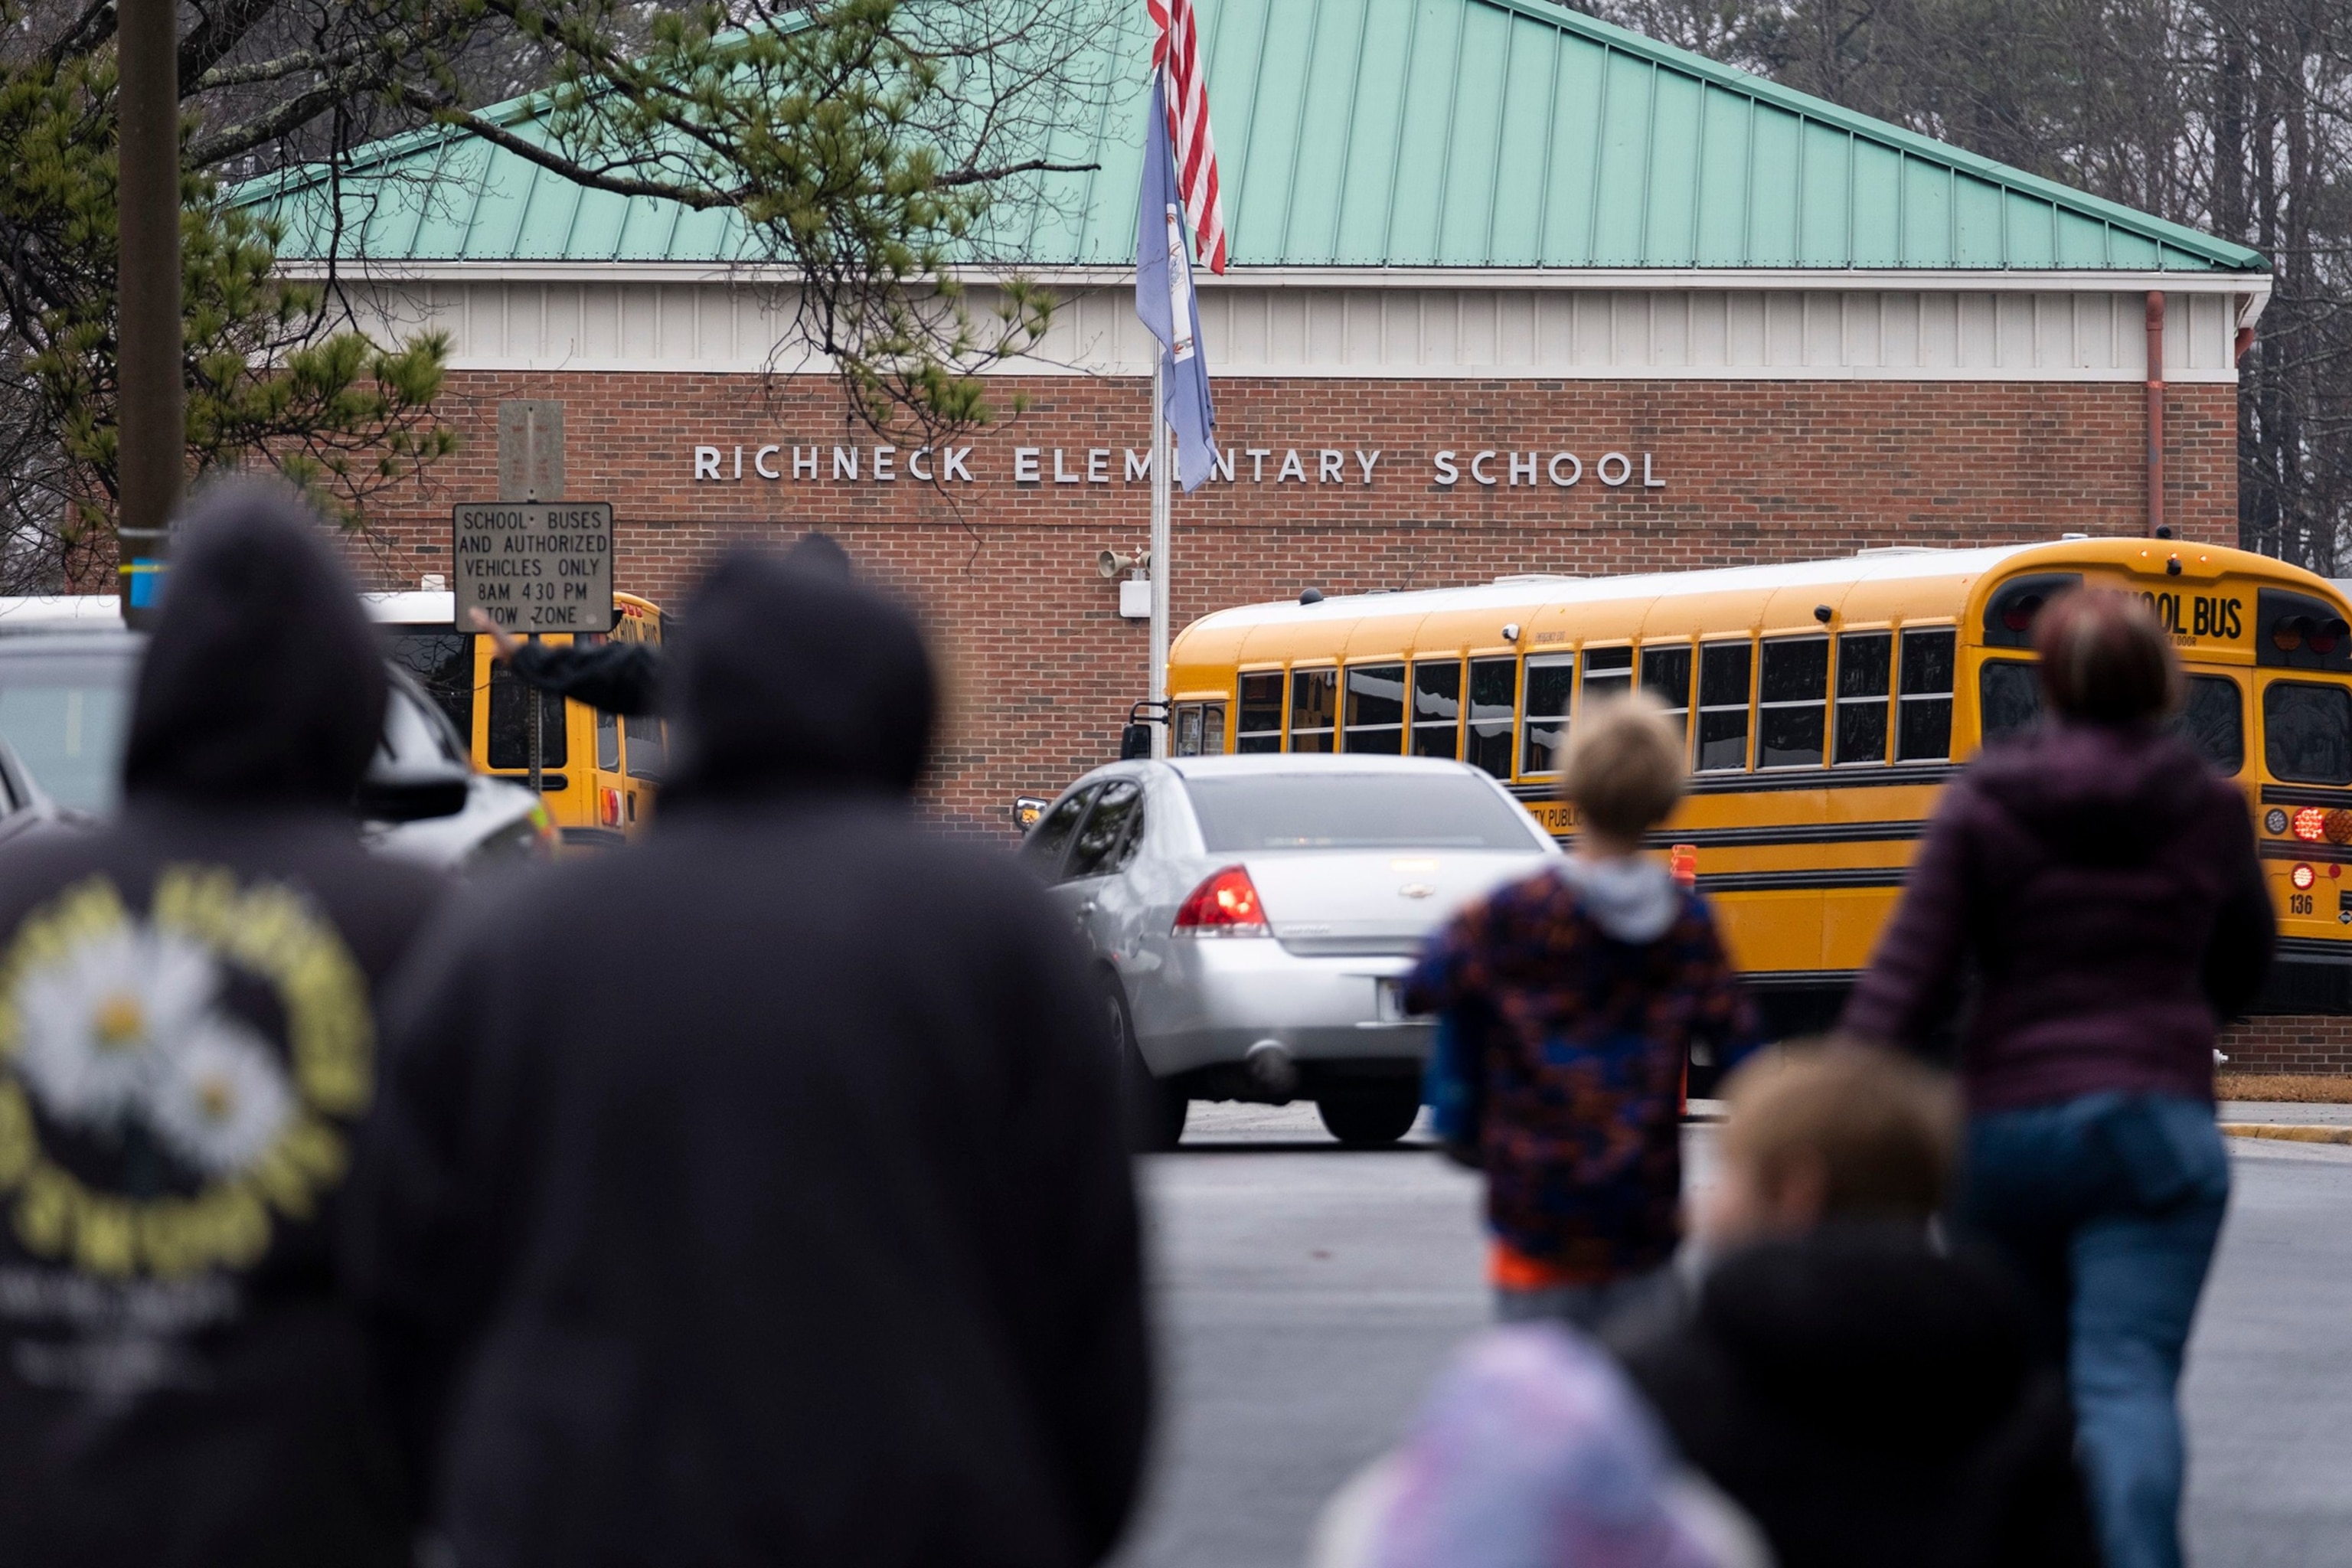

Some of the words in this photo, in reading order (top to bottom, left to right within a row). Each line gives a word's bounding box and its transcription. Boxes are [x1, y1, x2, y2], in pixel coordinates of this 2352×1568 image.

[694, 445, 973, 483] RICHNECK
[1434, 449, 1666, 487] SCHOOL
[464, 511, 527, 530] SCHOOL
[548, 511, 602, 529] BUSES
[459, 536, 492, 553] AND
[504, 535, 607, 553] AUTHORIZED
[466, 559, 541, 577] VEHICLES
[558, 558, 599, 576] ONLY
[478, 583, 511, 600] 8AM
[564, 582, 587, 600] PM
[485, 606, 518, 624] TOW
[534, 606, 577, 624] ZONE
[2193, 596, 2243, 639] BUS
[2177, 635, 2197, 646] DOOR
[2290, 893, 2313, 915] 136
